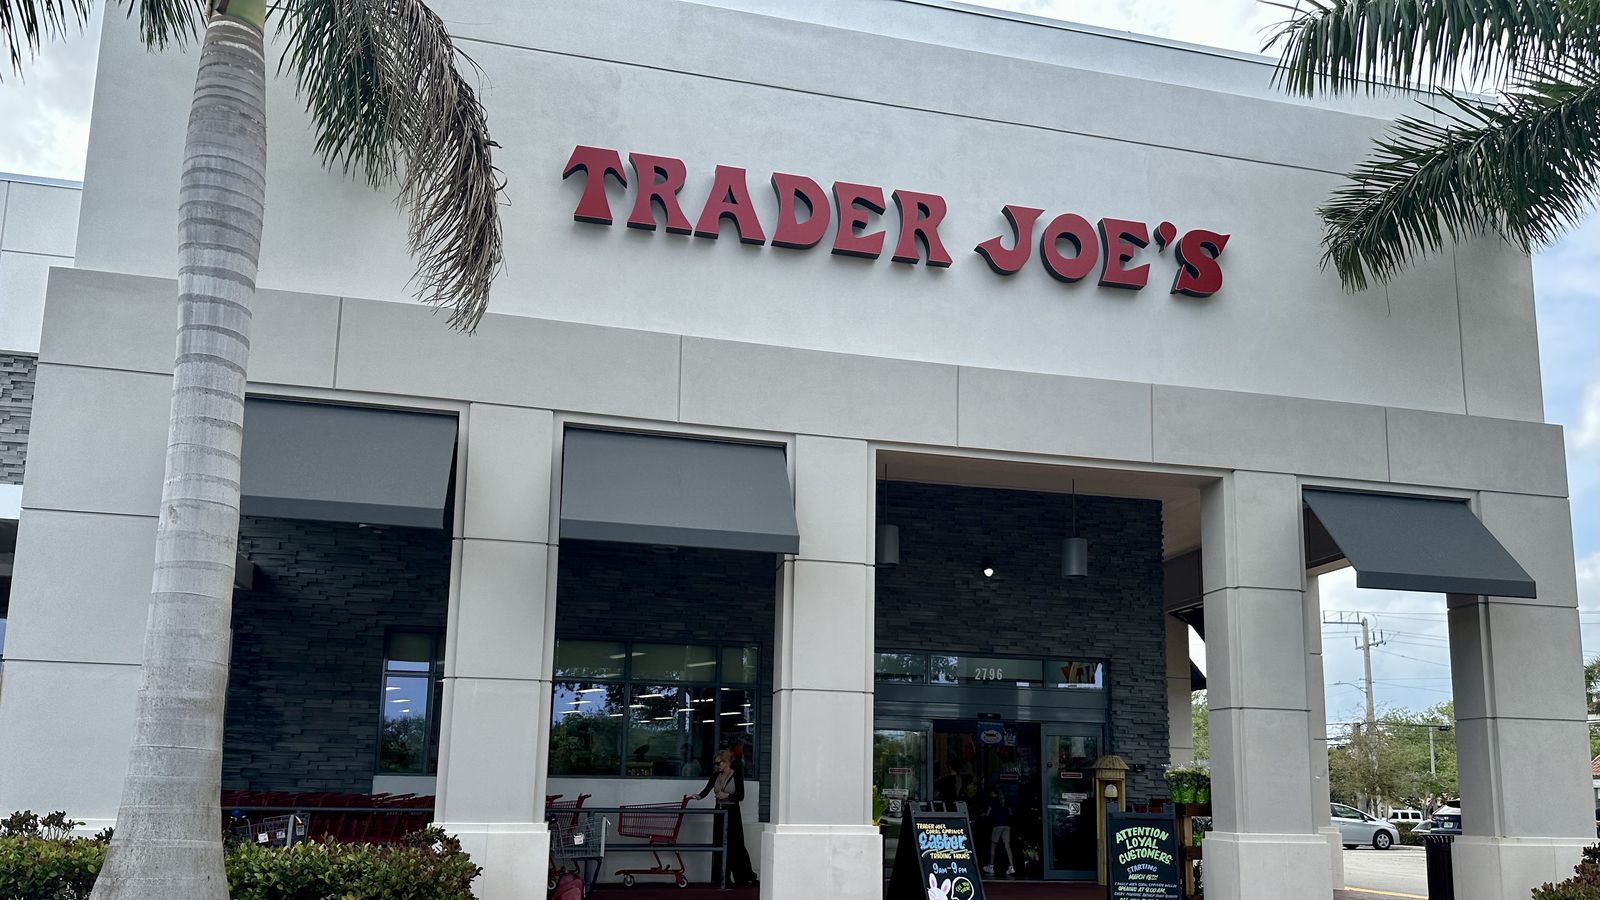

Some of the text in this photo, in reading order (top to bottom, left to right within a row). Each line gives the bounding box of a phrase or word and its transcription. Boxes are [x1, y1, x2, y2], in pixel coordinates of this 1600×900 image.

[562, 144, 1231, 298] TRADER JOE'S
[975, 668, 1003, 680] 2796
[919, 832, 967, 849] Easter
[1116, 827, 1169, 843] ATTENTION
[1126, 837, 1158, 849] LOYAL
[1127, 864, 1157, 874] STARTING
